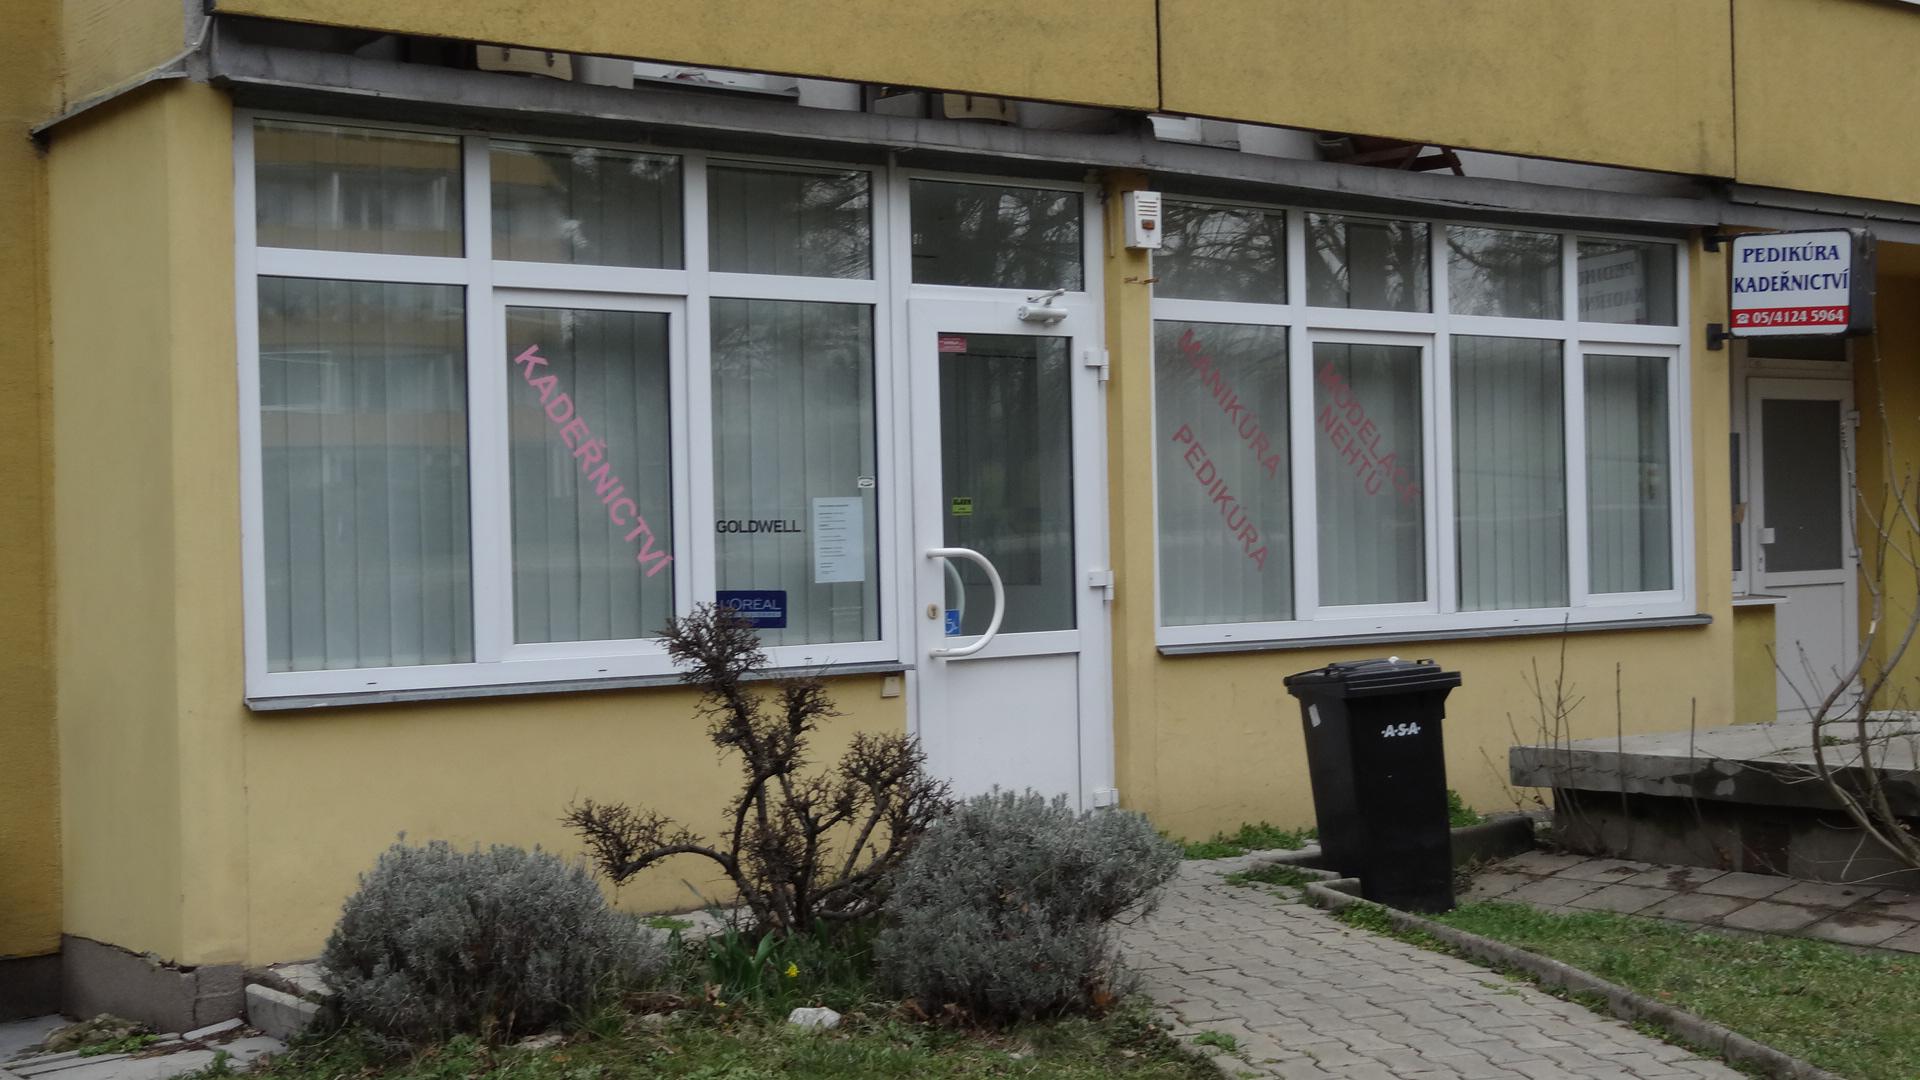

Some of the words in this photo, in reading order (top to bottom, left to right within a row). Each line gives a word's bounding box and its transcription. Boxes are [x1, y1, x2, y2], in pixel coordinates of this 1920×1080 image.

[1742, 242, 1840, 263] PEDIKÚRA
[1734, 268, 1849, 293] KADEŘNICTVÍ
[1752, 310, 1808, 325] 05/4124
[1811, 309, 1844, 322] 5964
[514, 344, 674, 577] KADEŘNICTVÍ
[716, 520, 801, 533] GOLDWELL
